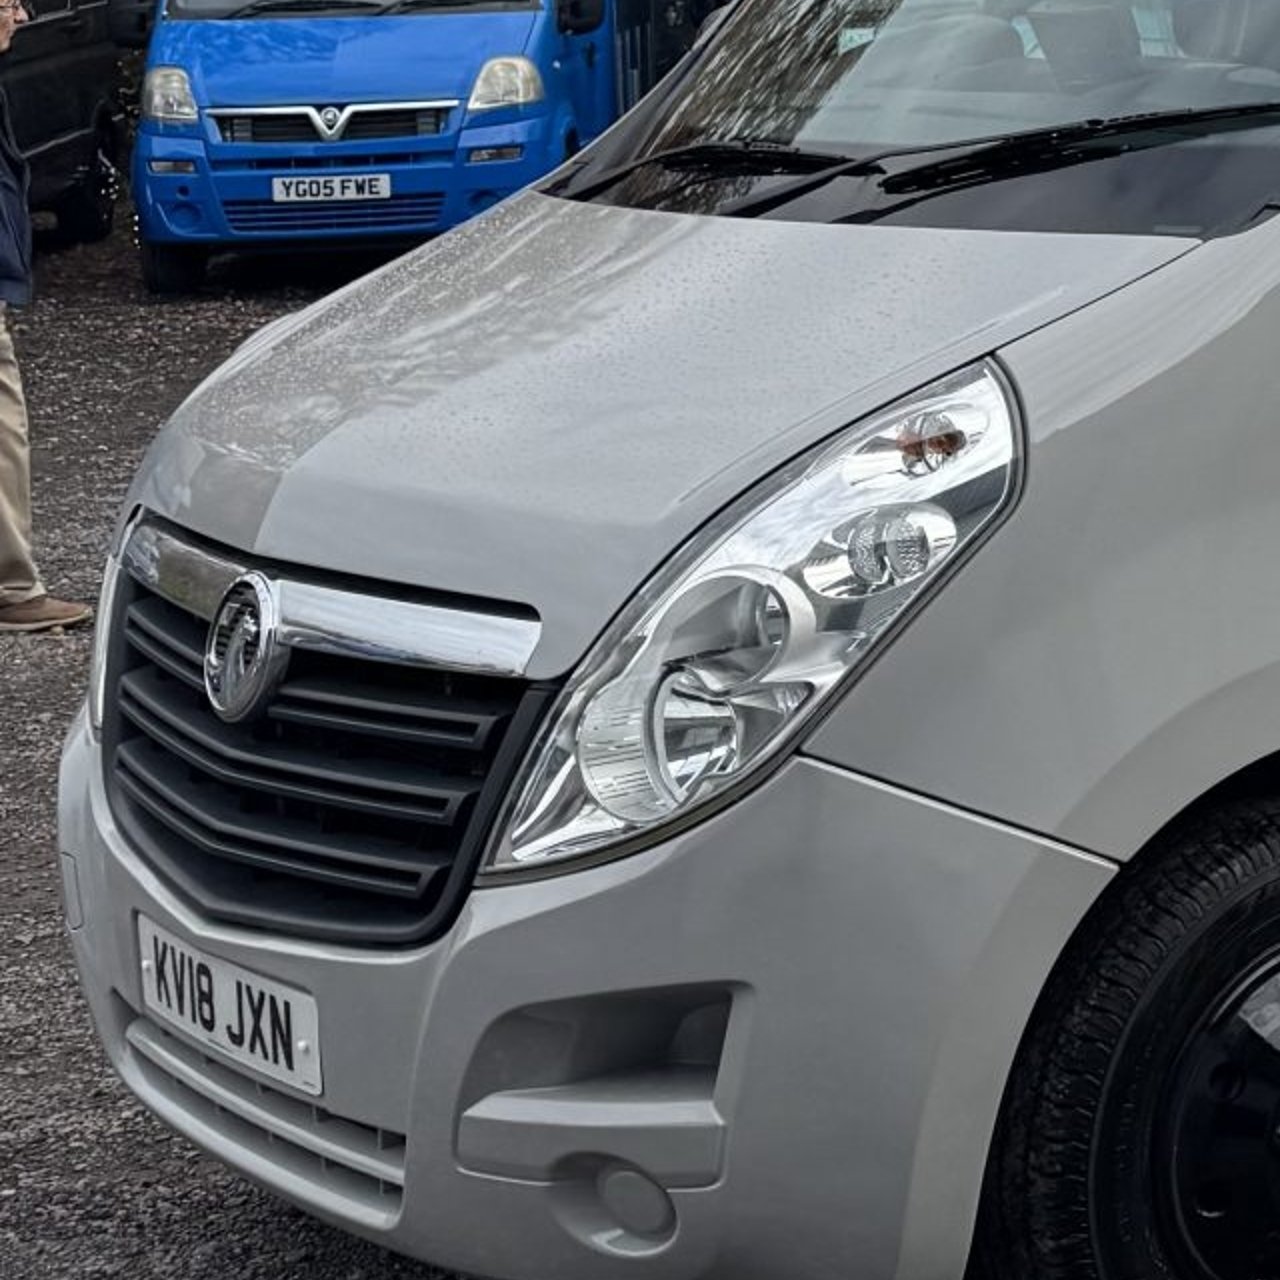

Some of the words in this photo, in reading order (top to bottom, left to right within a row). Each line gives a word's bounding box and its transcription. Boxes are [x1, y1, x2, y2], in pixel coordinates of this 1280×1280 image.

[281, 179, 335, 198] YG05
[340, 177, 381, 196] FWE
[153, 935, 215, 1032] KV18
[226, 980, 294, 1071] JXN
